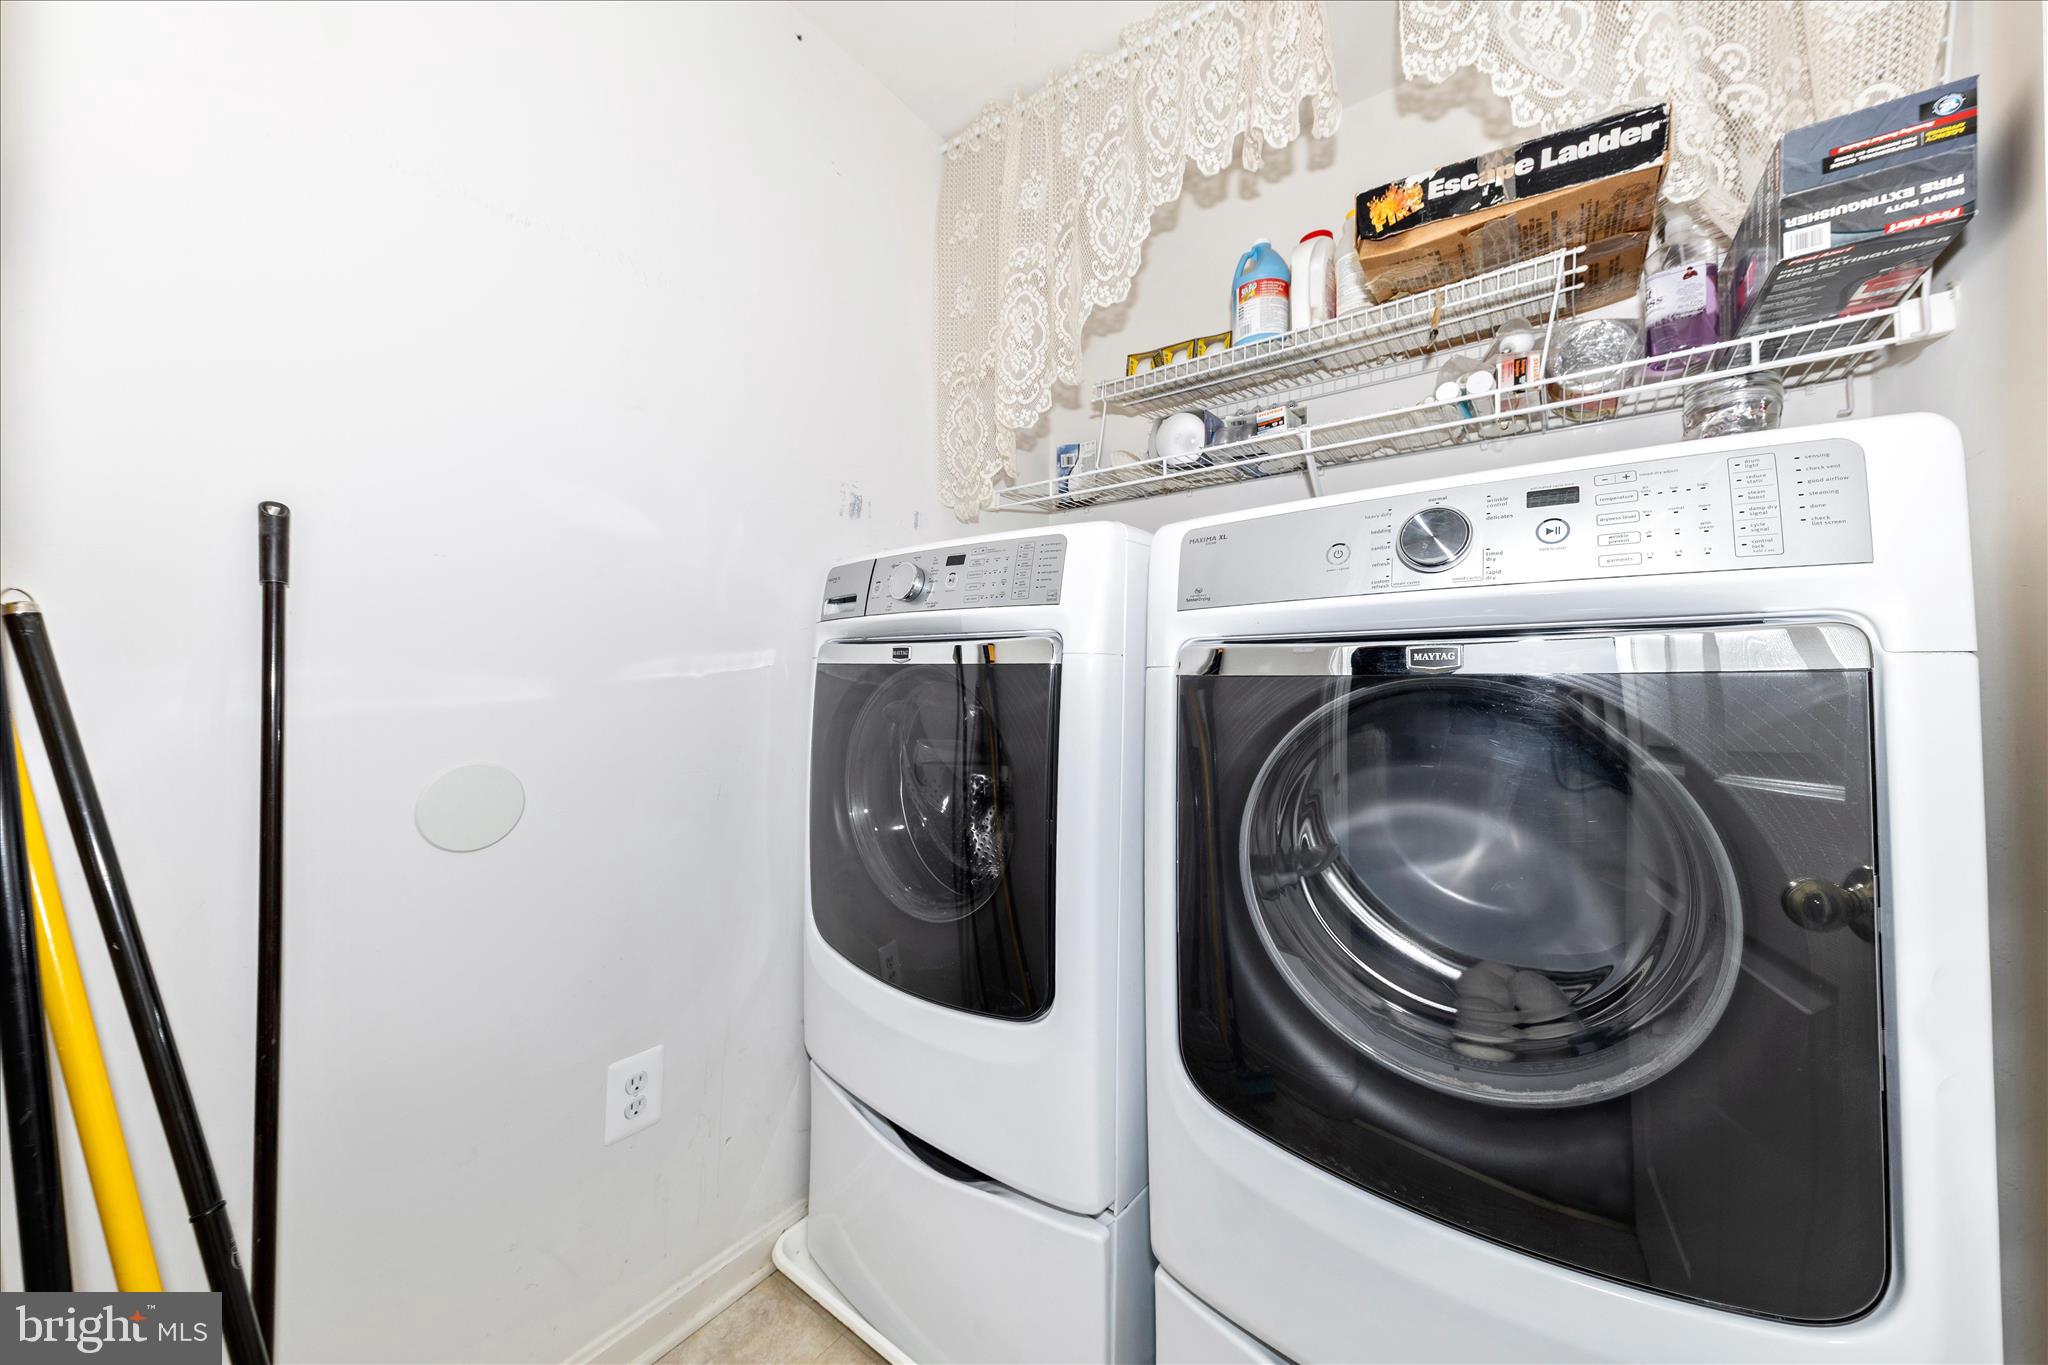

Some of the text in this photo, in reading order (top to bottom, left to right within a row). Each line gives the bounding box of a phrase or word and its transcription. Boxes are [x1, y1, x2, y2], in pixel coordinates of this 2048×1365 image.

[1428, 120, 1661, 200] Escape Ladder
[1784, 173, 1964, 229] FIRE EXTINGUISHER
[1884, 187, 1965, 214] HEAVY DUTY
[1887, 208, 1961, 234] First Alert
[1776, 235, 1952, 281] FIRE EXTINGUISHER
[1779, 262, 1815, 275] HEAVY
[1189, 536, 1217, 545] MAXIMA
[1413, 652, 1456, 661] MAYTAG
